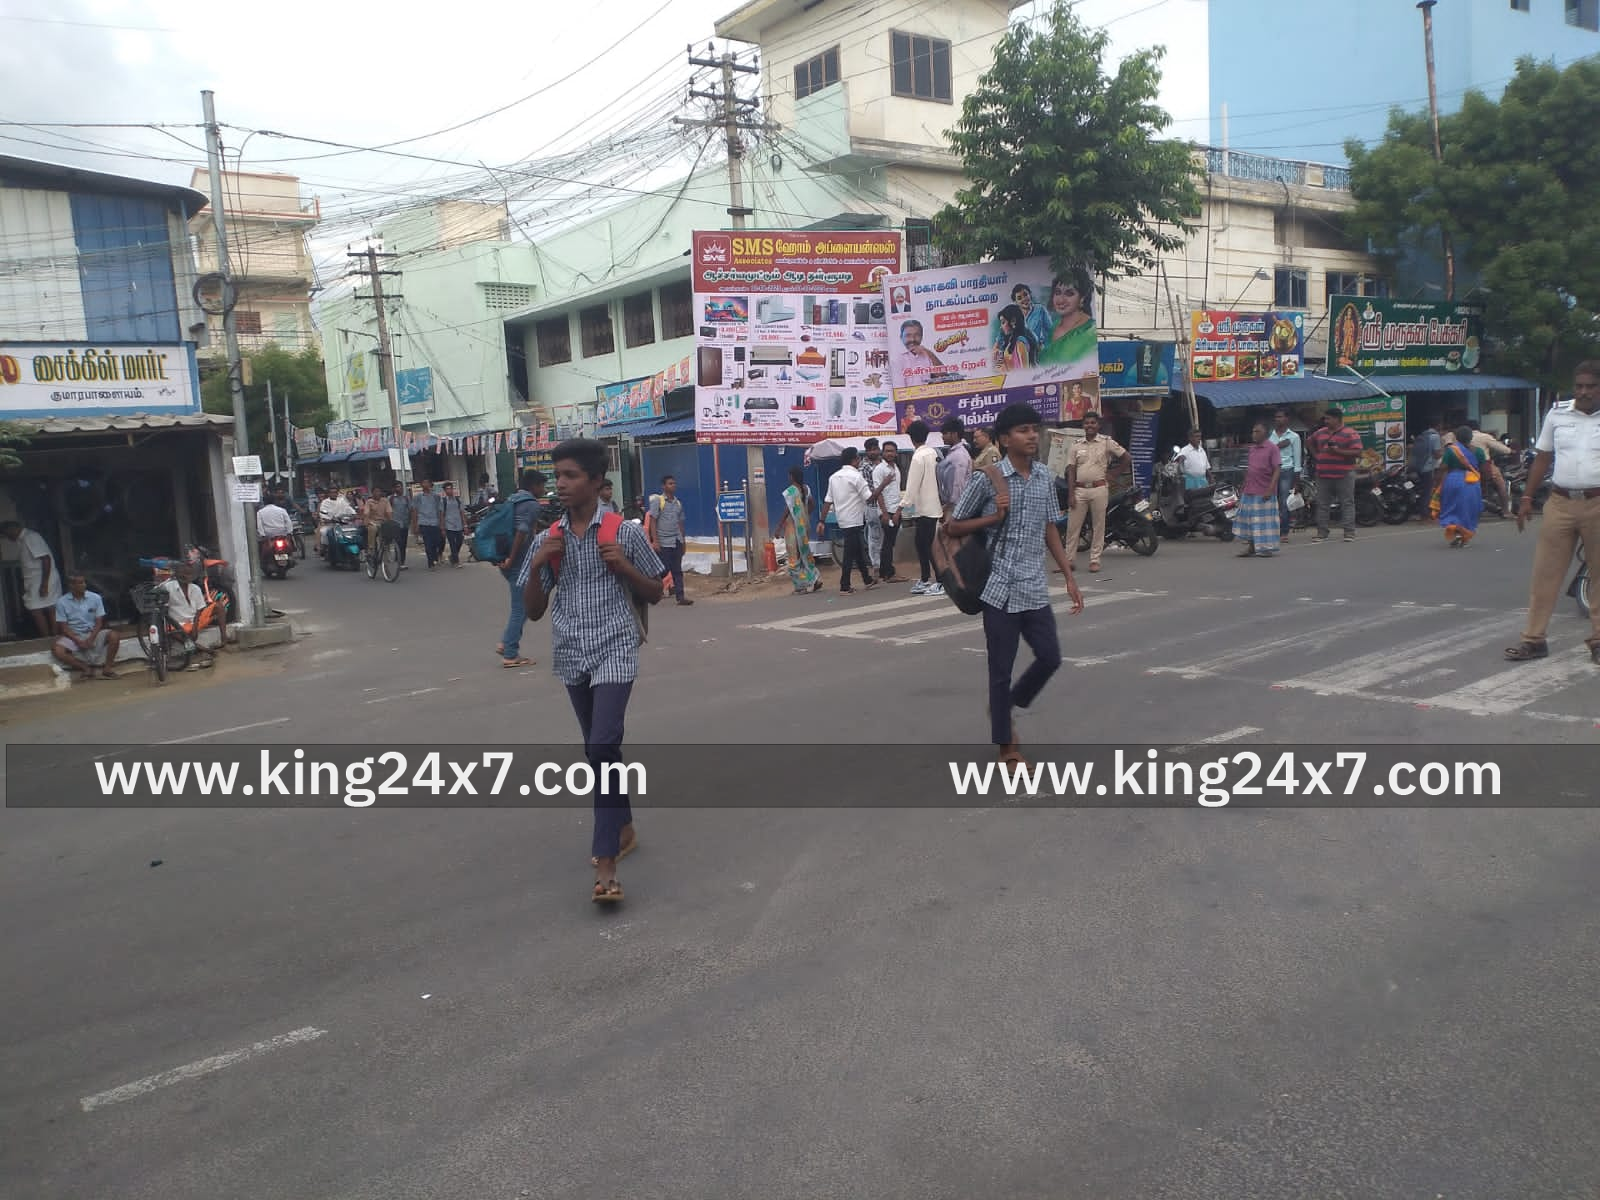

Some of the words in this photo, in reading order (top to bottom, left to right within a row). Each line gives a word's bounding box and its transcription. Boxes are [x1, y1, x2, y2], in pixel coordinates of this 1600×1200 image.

[732, 237, 774, 256] SMS
[775, 239, 811, 256] ஹோம்
[783, 270, 806, 283] ஆடி
[807, 267, 853, 284] தள்ளுபடி
[913, 278, 958, 294] மகாகவி
[960, 272, 1009, 289] பாரதியார்
[925, 292, 999, 311] நாடகப்பட்டறை
[1232, 318, 1266, 336] முருகன்
[1362, 311, 1383, 350] ஸ்ரீ
[1382, 314, 1428, 350] முருகன்
[1429, 315, 1469, 346] பேக்கரி
[33, 348, 119, 383] சைக்கிள்
[122, 348, 169, 382] மார்ட்
[958, 393, 1008, 410] சத்யா
